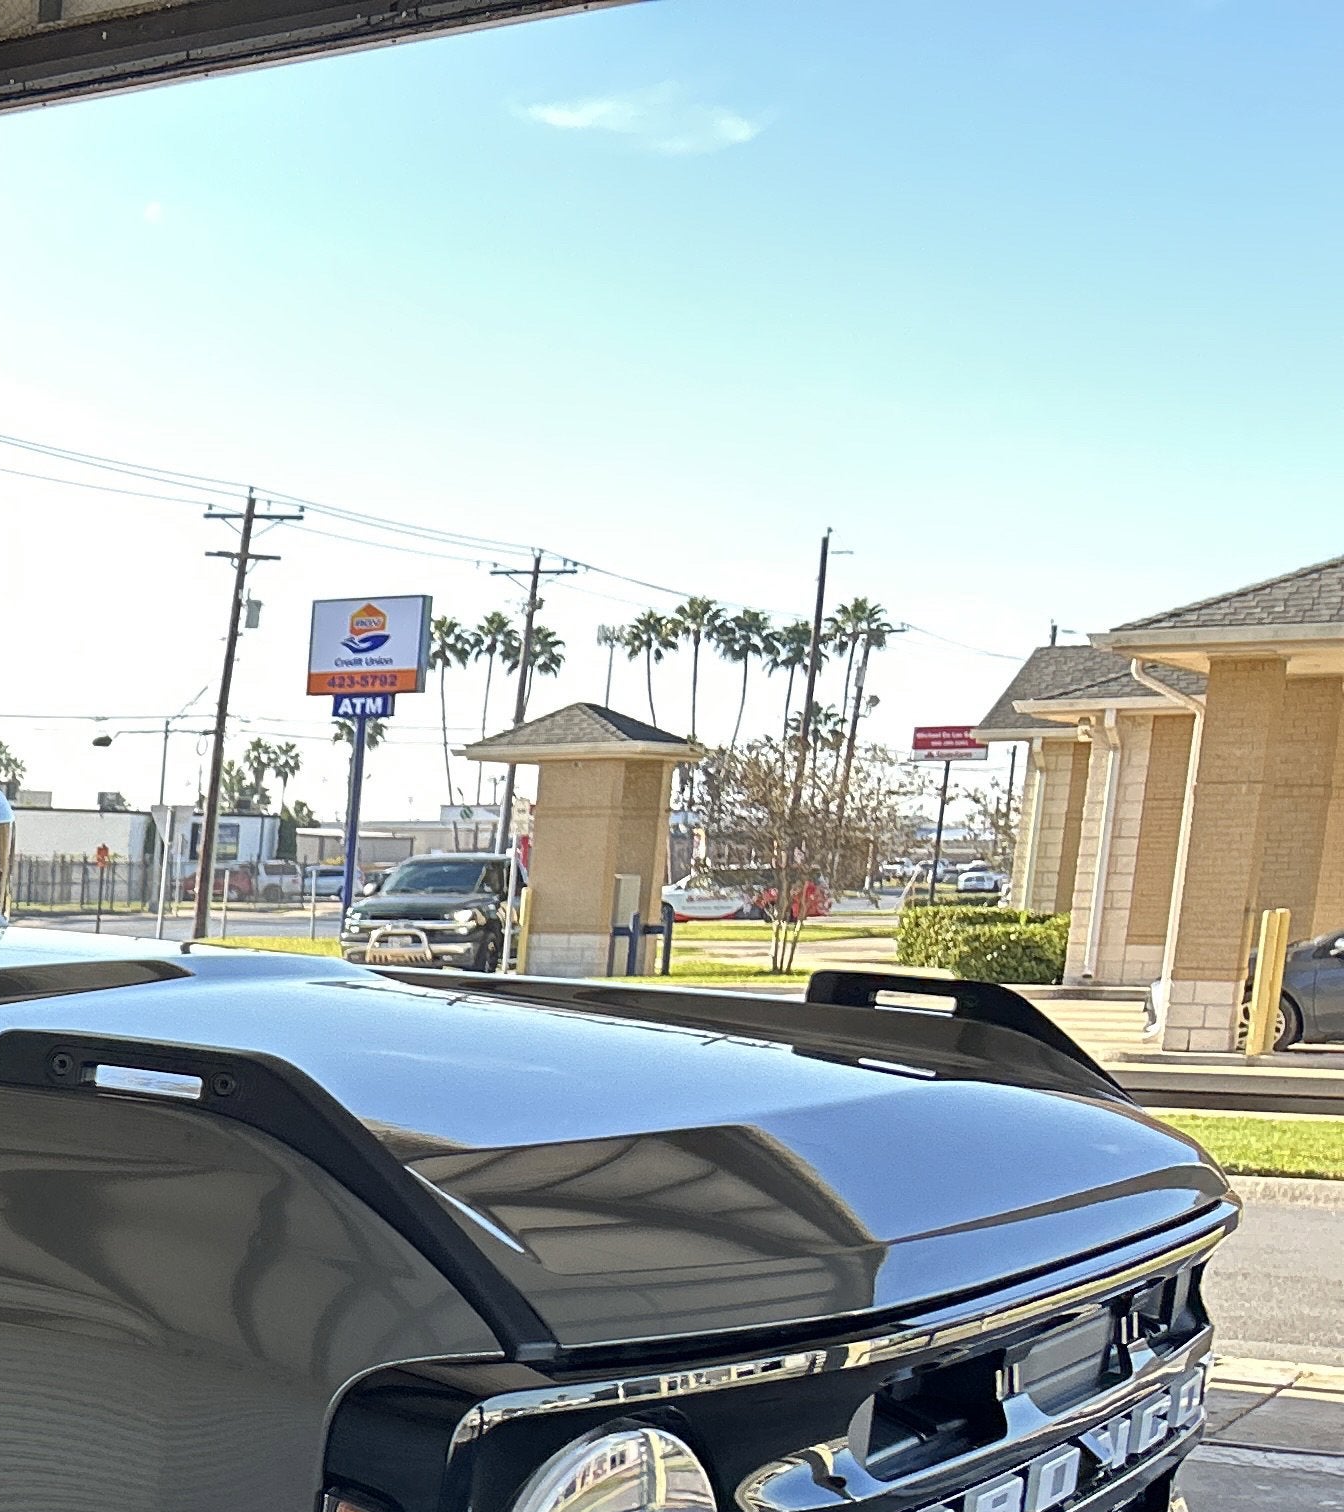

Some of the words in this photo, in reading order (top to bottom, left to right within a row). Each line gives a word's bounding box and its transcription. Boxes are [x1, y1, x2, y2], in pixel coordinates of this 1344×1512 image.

[334, 657, 363, 668] Credit
[365, 656, 393, 667] Union
[338, 696, 383, 715] ATM
